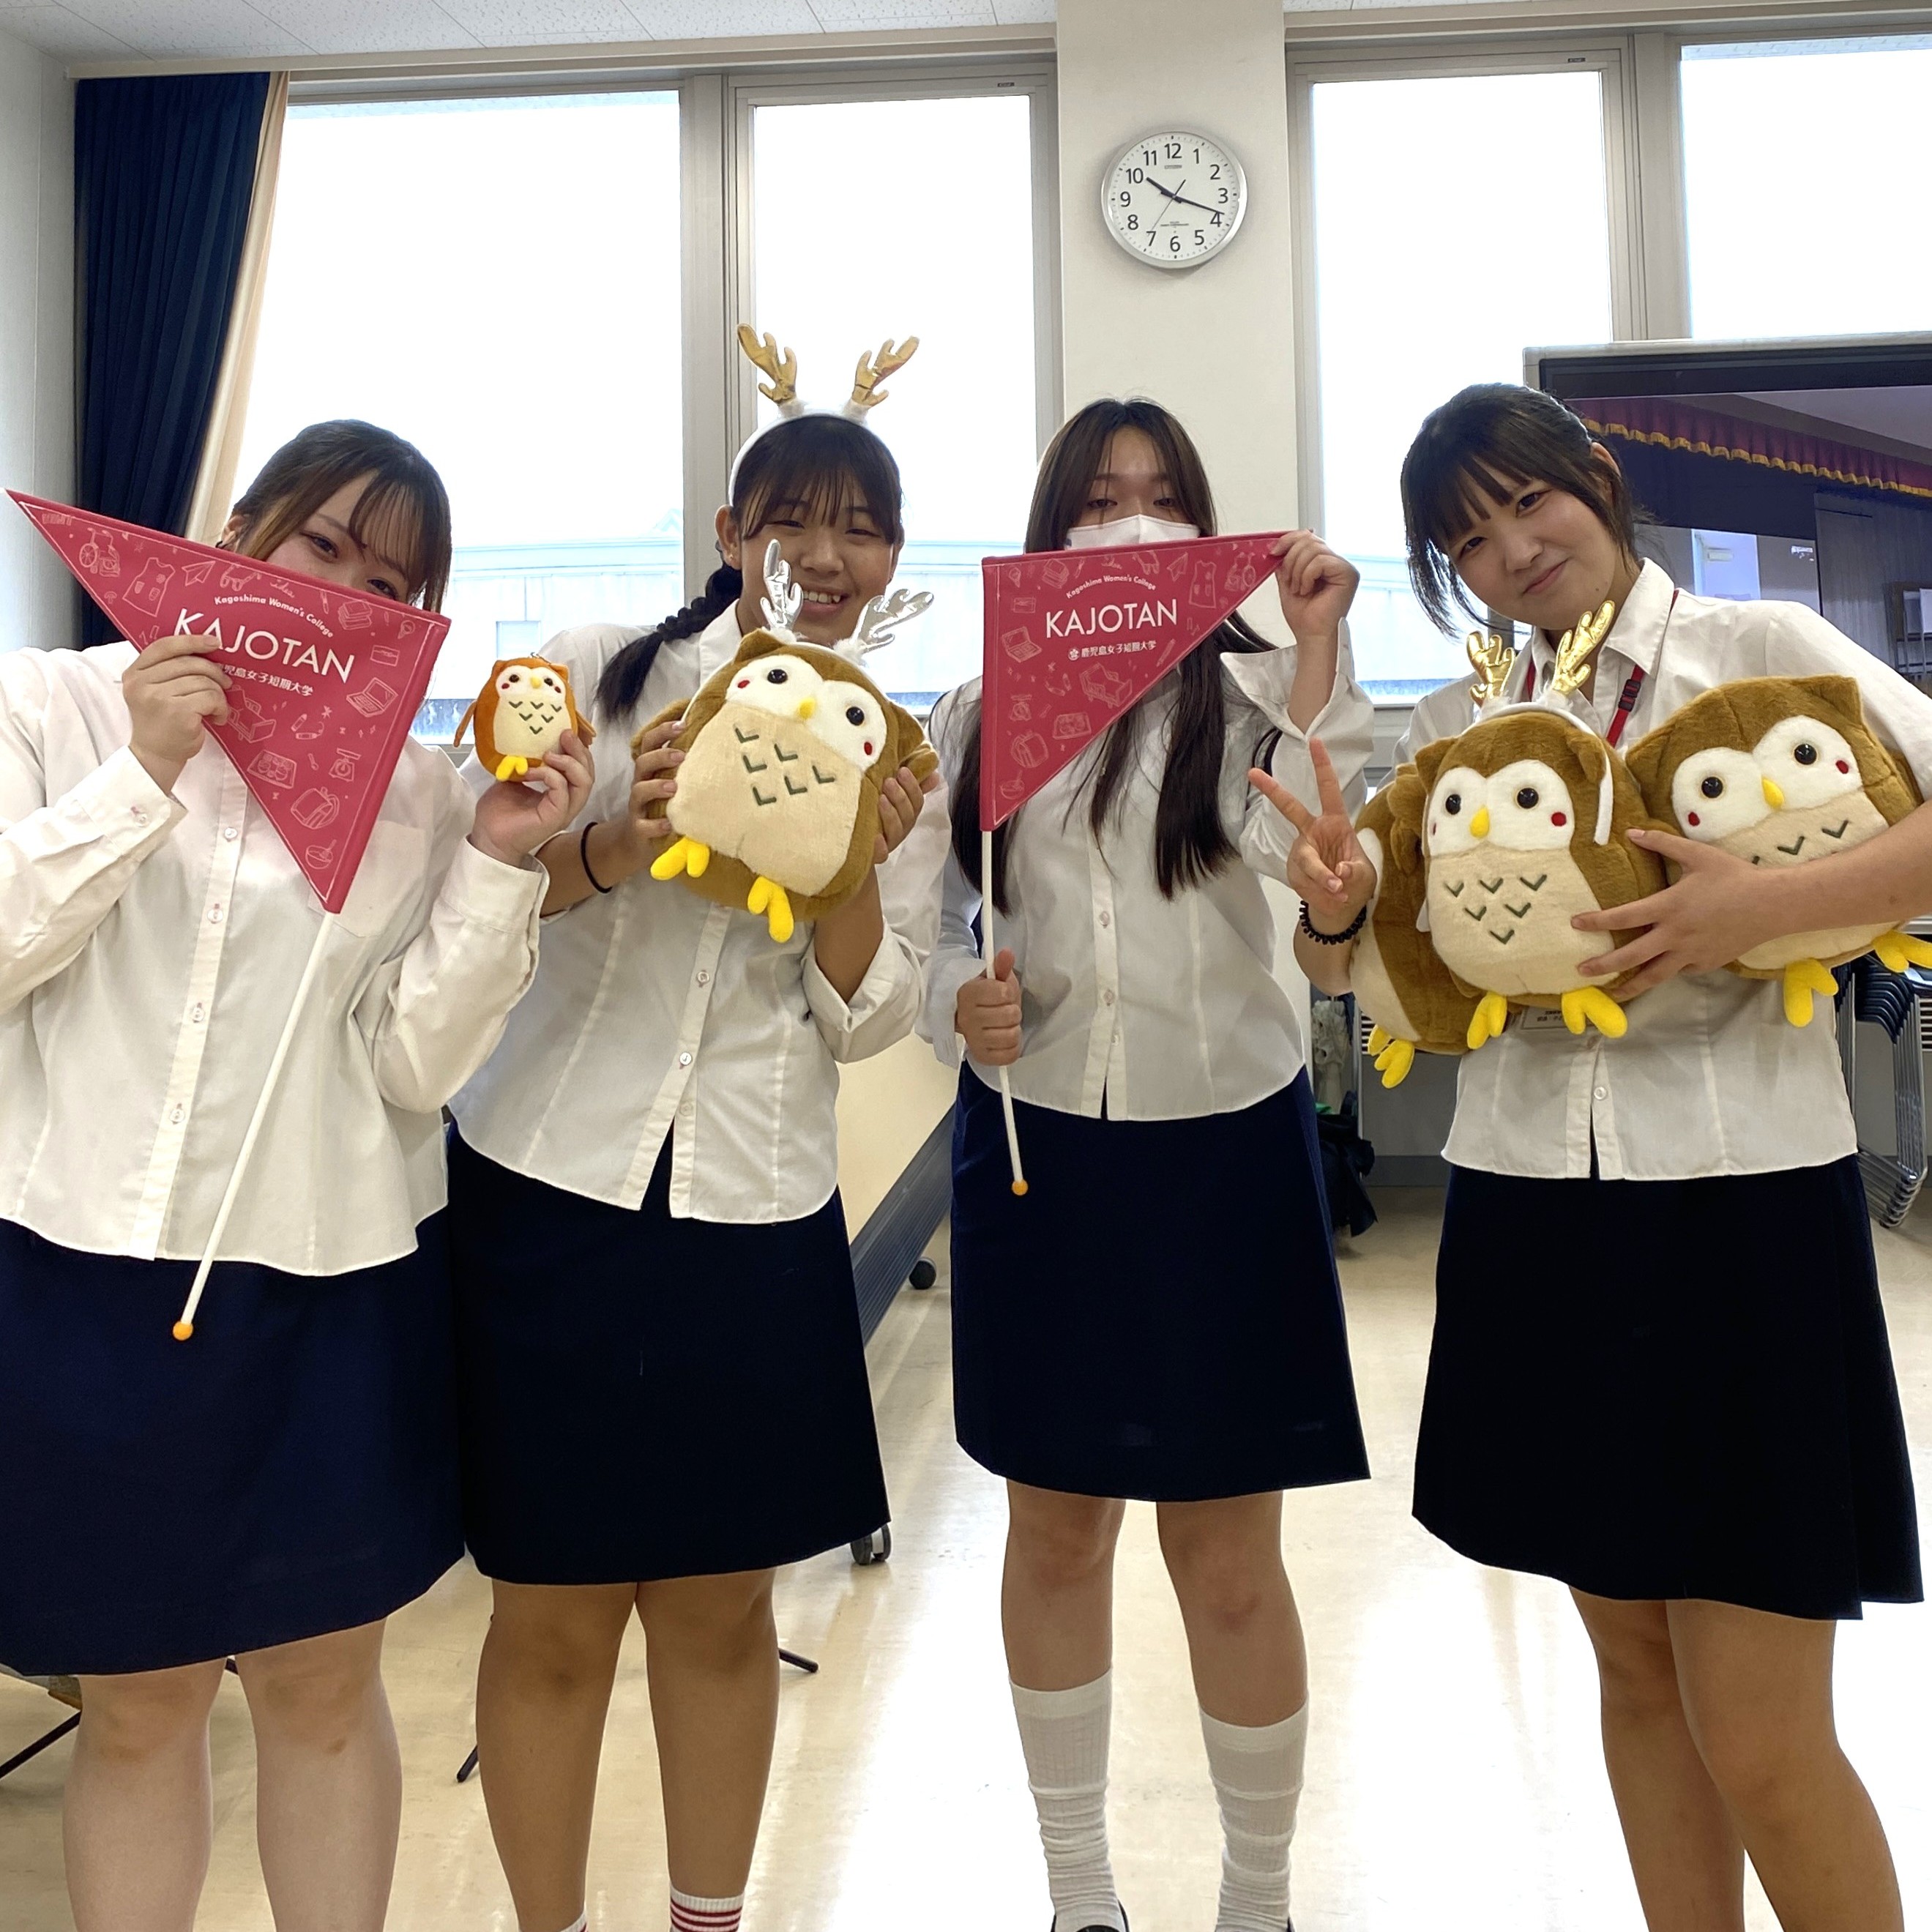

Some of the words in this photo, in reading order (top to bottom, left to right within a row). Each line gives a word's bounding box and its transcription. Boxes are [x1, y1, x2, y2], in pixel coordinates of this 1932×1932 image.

[1143, 150, 1157, 165] 11
[1164, 143, 1182, 159] 12
[1193, 148, 1199, 164] 1
[1125, 168, 1144, 184] 10
[1209, 164, 1220, 180] 2
[1120, 191, 1131, 207] 9
[1217, 187, 1228, 204] 3
[1127, 215, 1138, 230] 8
[1209, 212, 1223, 228] 4
[1146, 231, 1157, 247] 7
[1170, 236, 1181, 252] 6
[1194, 229, 1205, 245] 5
[1066, 578, 1103, 599] Kagoshima
[1103, 574, 1132, 583] Women's
[1133, 576, 1156, 591] College
[215, 594, 267, 606] Kagoshima
[269, 597, 305, 618] Women's
[306, 613, 334, 638] College
[1046, 598, 1177, 638] KAJOTAN
[174, 608, 355, 684] KAJOTAN
[1081, 640, 1157, 658] 鹿児島女子短期大学
[223, 664, 313, 696] 児島女子短期大学
